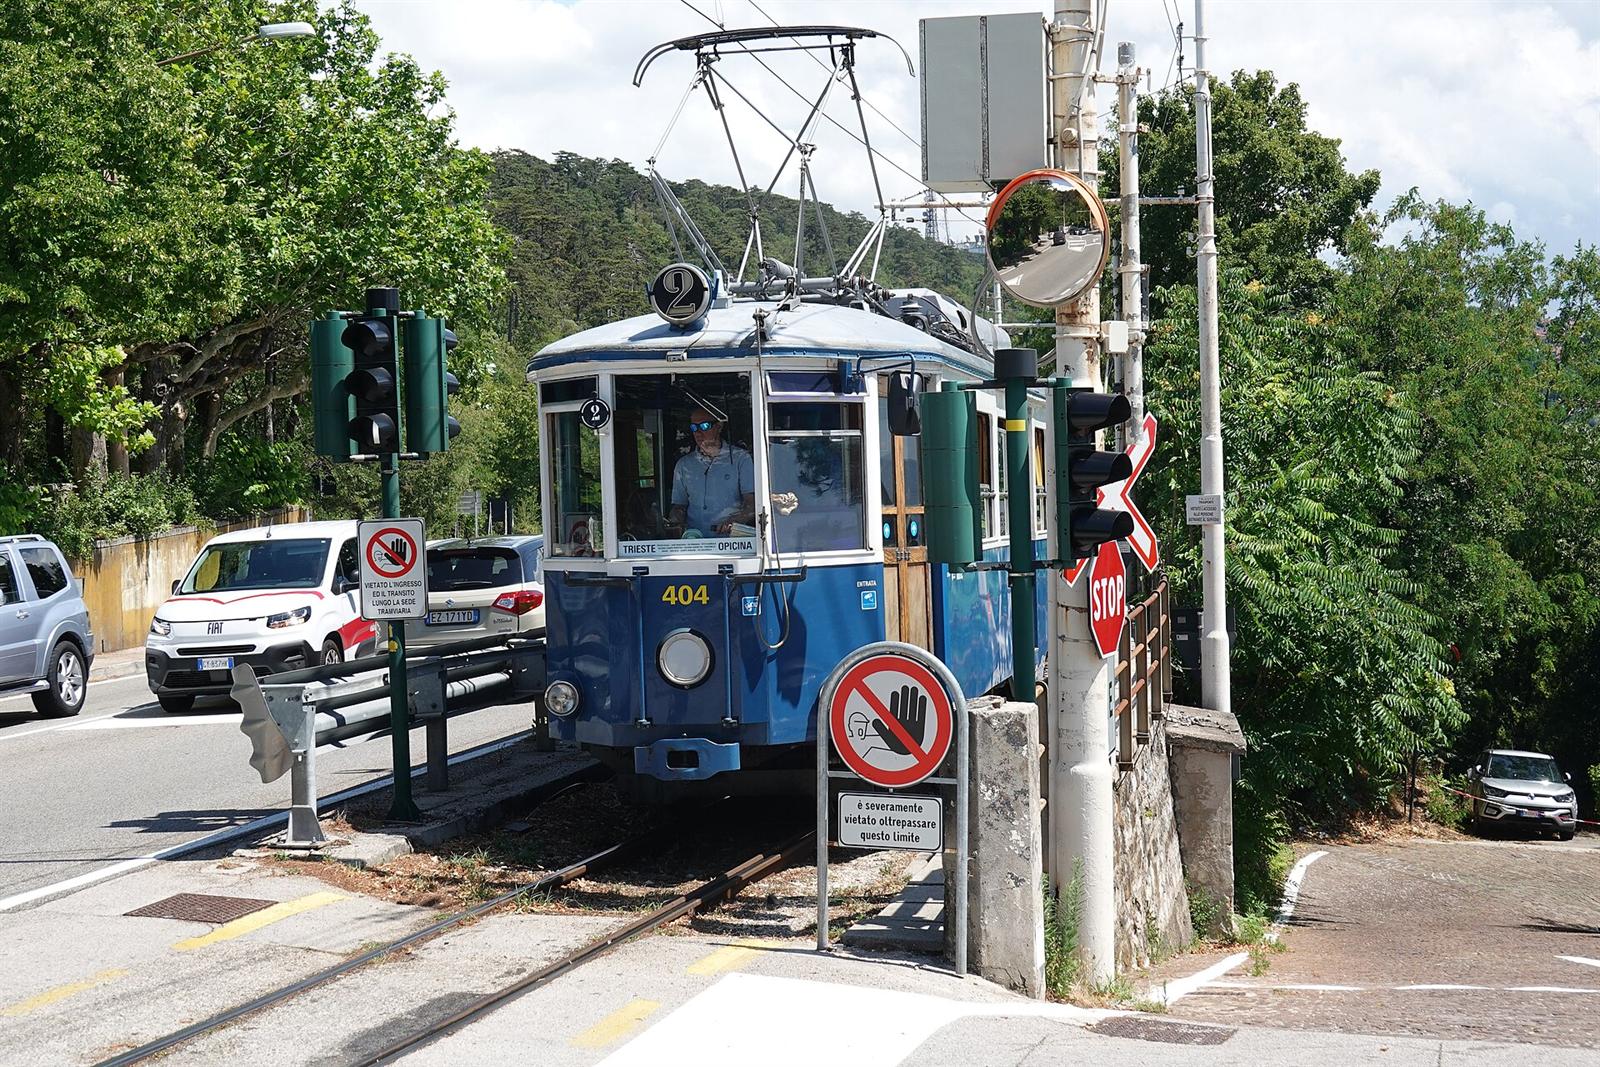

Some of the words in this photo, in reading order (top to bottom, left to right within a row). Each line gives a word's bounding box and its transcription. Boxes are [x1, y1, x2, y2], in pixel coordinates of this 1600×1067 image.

[663, 267, 696, 317] 2
[590, 404, 601, 421] 2
[623, 544, 656, 554] TRIESTE
[718, 541, 753, 551] OPICINA
[389, 580, 422, 588] L'INGRESSO
[856, 580, 877, 588] ENTRATA
[662, 584, 710, 606] 404
[1092, 574, 1124, 622] STOP
[401, 598, 416, 606] SEDE
[207, 622, 224, 635] FIAT
[865, 802, 923, 814] severamente
[844, 813, 877, 826] vietato
[879, 816, 937, 829] oltrepassare
[860, 831, 890, 842] questo
[893, 831, 920, 843] limite
